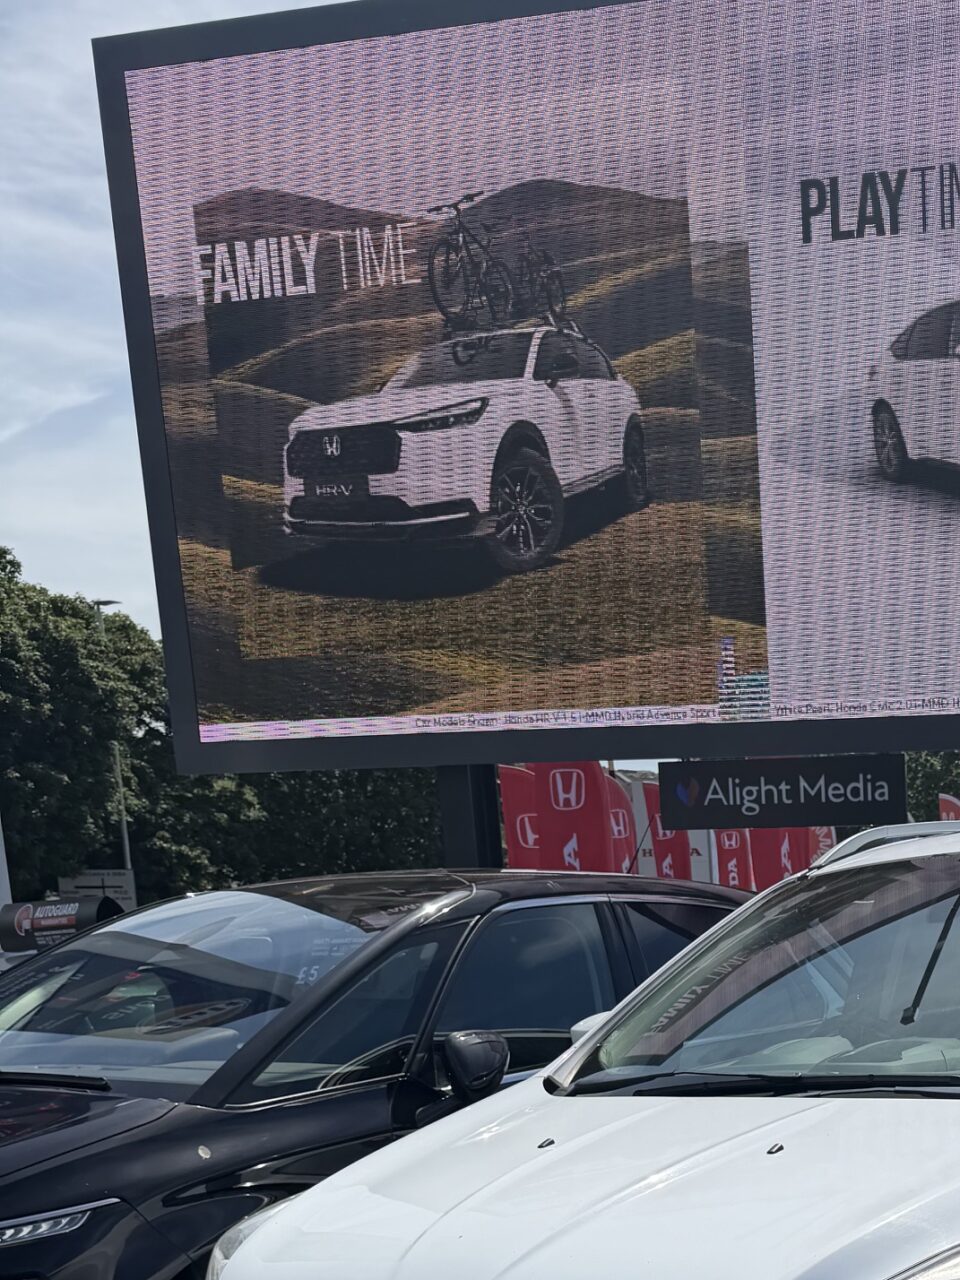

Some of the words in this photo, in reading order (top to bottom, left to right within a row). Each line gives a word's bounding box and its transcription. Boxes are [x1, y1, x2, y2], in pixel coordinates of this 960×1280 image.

[192, 233, 319, 305] FAMILY
[328, 222, 422, 290] TIME
[315, 484, 353, 497] HR-V
[704, 776, 793, 816] Alight
[799, 773, 889, 804] Media
[34, 903, 79, 918] AUTOGUARD
